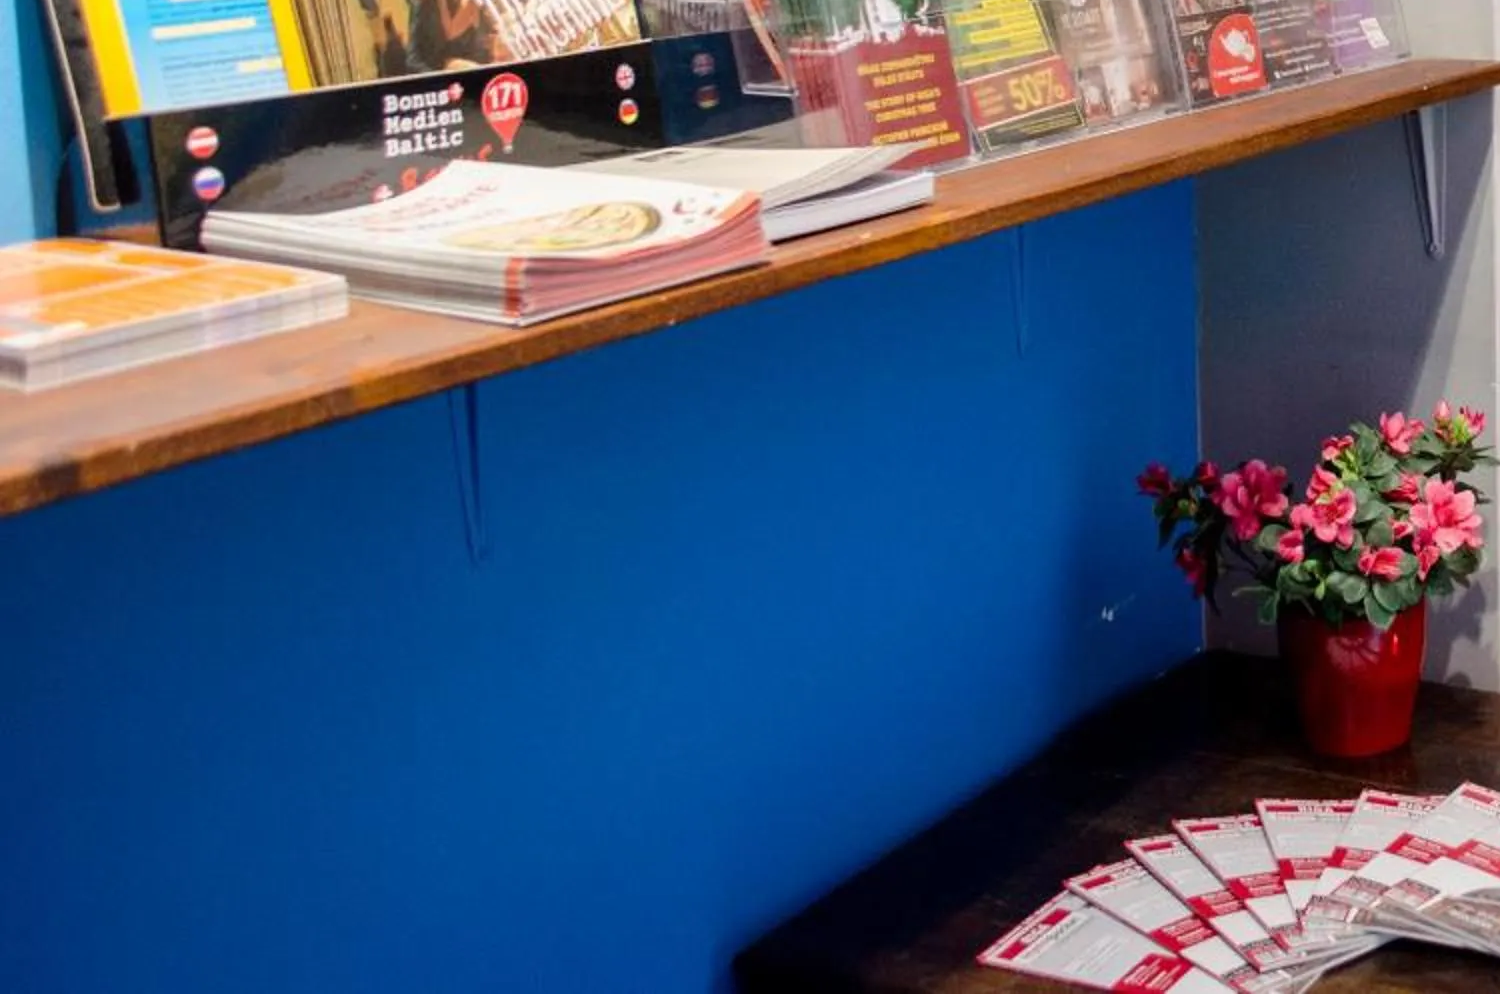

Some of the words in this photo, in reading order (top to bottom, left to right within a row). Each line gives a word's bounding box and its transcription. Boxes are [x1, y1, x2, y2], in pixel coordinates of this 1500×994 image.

[487, 81, 522, 109] 171
[384, 108, 464, 136] Medien
[385, 129, 464, 158] Baltic
